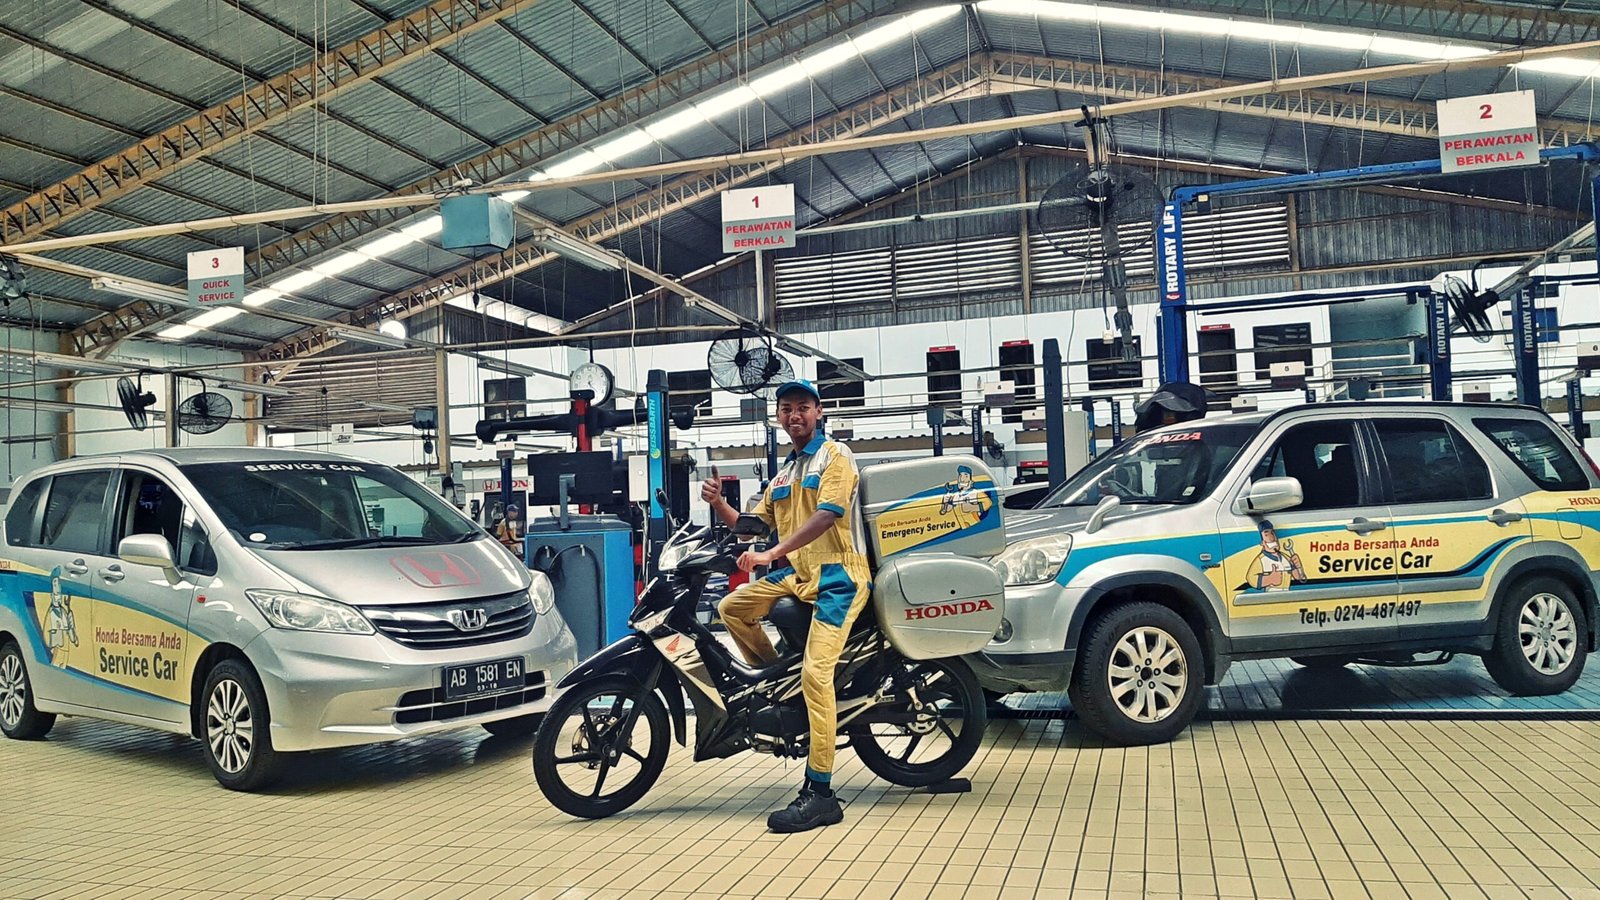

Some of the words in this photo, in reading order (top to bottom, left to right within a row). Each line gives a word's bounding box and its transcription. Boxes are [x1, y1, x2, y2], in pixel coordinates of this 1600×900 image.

[1479, 104, 1493, 119] 2
[1444, 133, 1534, 151] PERAWATAN
[1456, 150, 1525, 166] BERKALA
[752, 195, 759, 208] 1
[725, 220, 792, 234] PERAWATAN
[733, 235, 785, 248] BERKALA
[211, 257, 219, 269] 3
[1164, 237, 1179, 292] ROTARY
[202, 279, 230, 289] QUICK
[198, 291, 235, 302] SERVICE
[1521, 289, 1531, 308] LIFT
[1436, 317, 1446, 354] ROTARY
[1522, 311, 1533, 348] ROTARY
[244, 463, 326, 472] SERVICE
[328, 464, 366, 472] CAR
[881, 526, 925, 539] Emergency
[926, 520, 956, 532] Service
[1310, 540, 1349, 552] Honda
[1354, 538, 1407, 551] Bersama
[1410, 536, 1440, 548] Anda
[1318, 553, 1394, 573] Service
[1400, 551, 1433, 569] Car
[905, 599, 994, 620] HONDA
[1299, 607, 1331, 627] Telp.
[95, 627, 119, 644] Honda
[121, 628, 157, 648] Bersama
[158, 631, 182, 650] Anda
[100, 647, 149, 677] Service
[153, 652, 178, 681] Car
[450, 668, 467, 688] AB
[475, 664, 499, 683] 1581
[506, 660, 520, 679] EN
